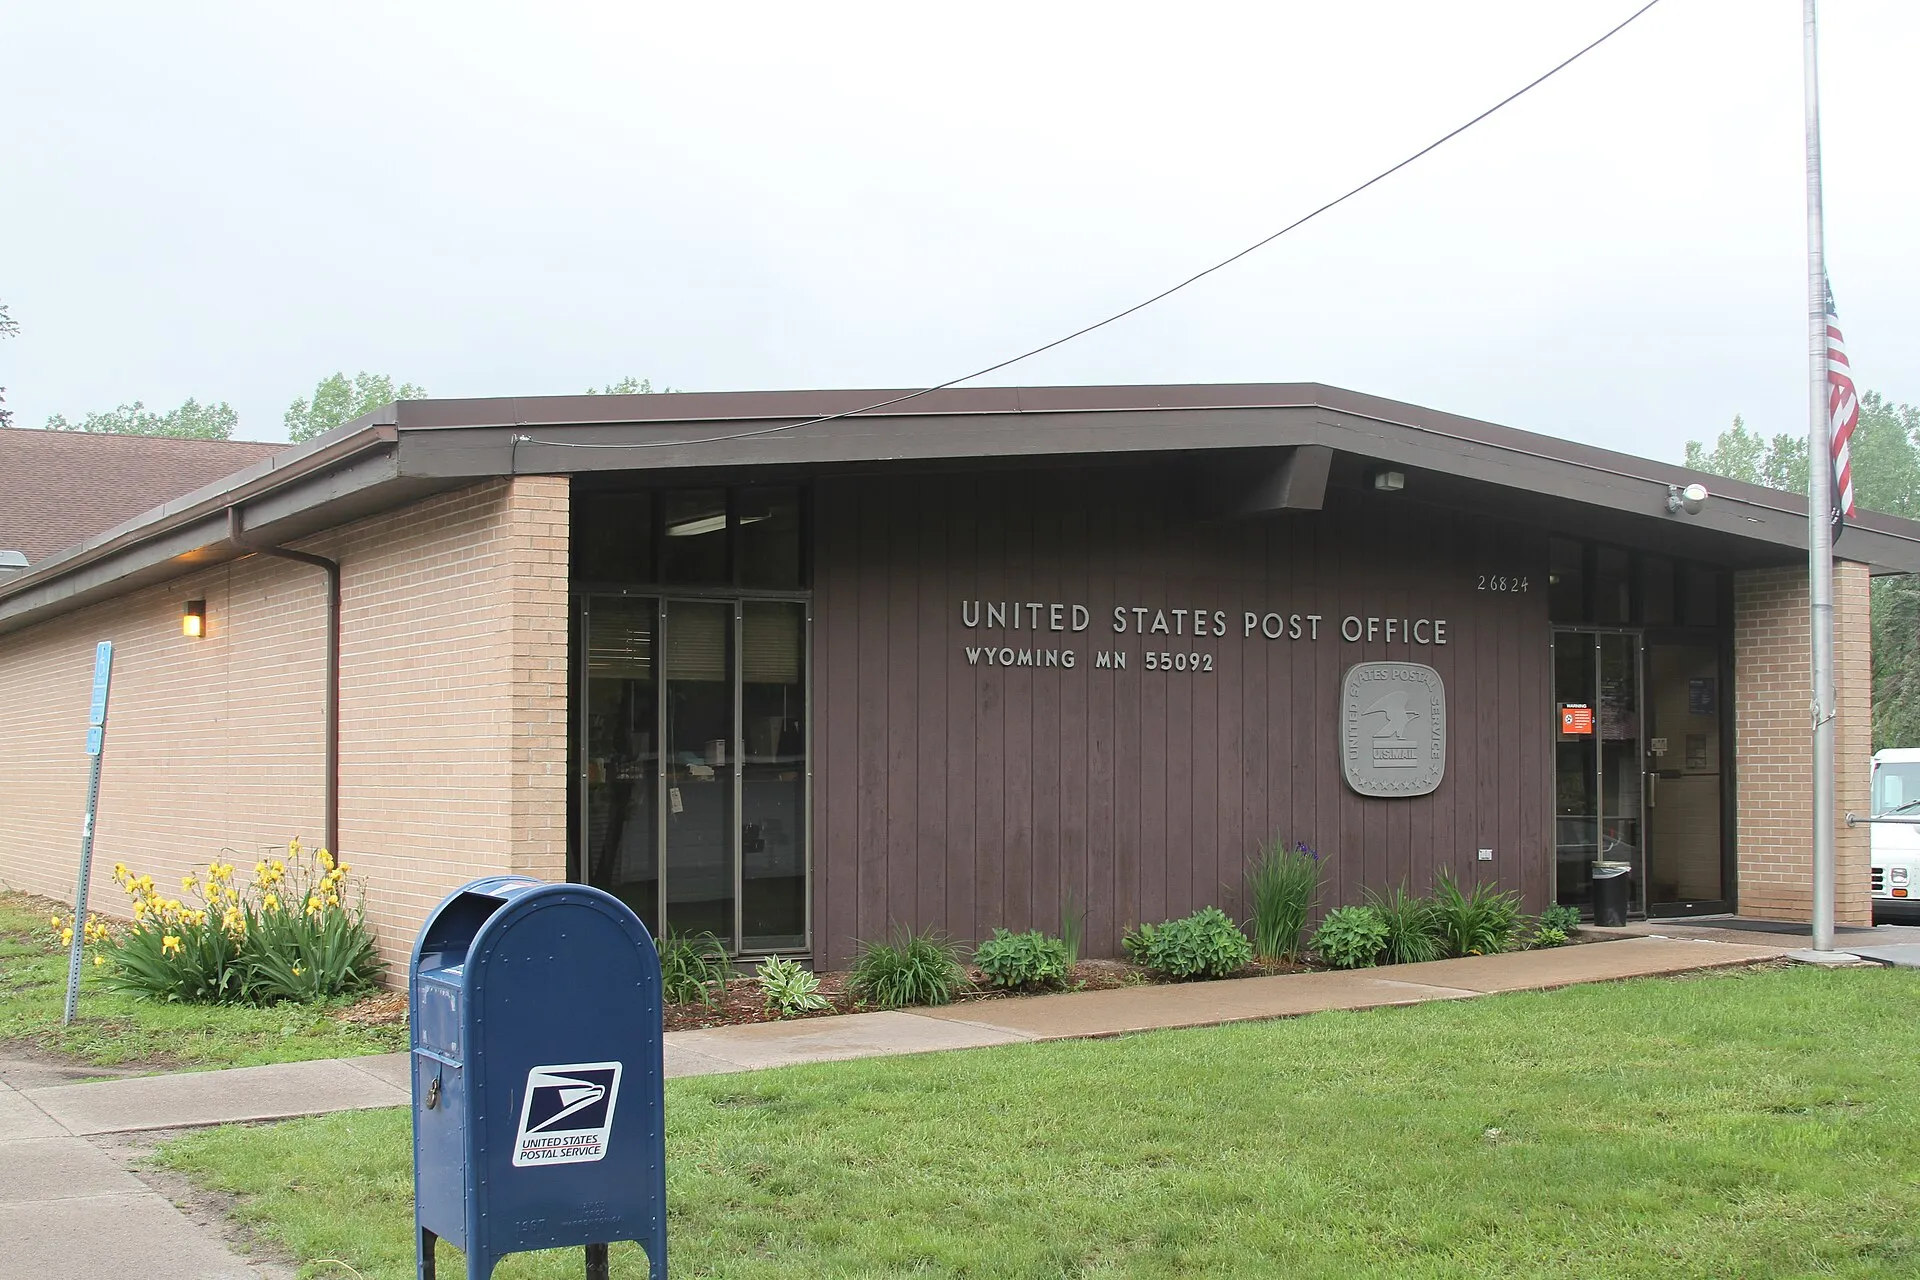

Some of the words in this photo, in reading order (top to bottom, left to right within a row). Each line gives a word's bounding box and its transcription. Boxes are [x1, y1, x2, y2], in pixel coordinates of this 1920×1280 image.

[1477, 575, 1529, 592] 26824
[962, 600, 1090, 632] UNITED
[1113, 606, 1227, 637] STATES
[1244, 612, 1322, 640] POST
[1341, 616, 1447, 645] OFFICE
[965, 646, 1075, 668] WYOMING
[1095, 651, 1126, 669] MN
[1145, 651, 1213, 671] 55092
[1350, 669, 1389, 698] STATES
[1391, 669, 1438, 692] POSTAL
[1349, 703, 1359, 760] UNITED
[1430, 696, 1441, 760] SERVICE
[520, 1149, 558, 1160] POSTAL
[559, 1145, 601, 1157] SERVICE
[522, 1137, 561, 1148] UNITED
[562, 1134, 598, 1146] STATES
